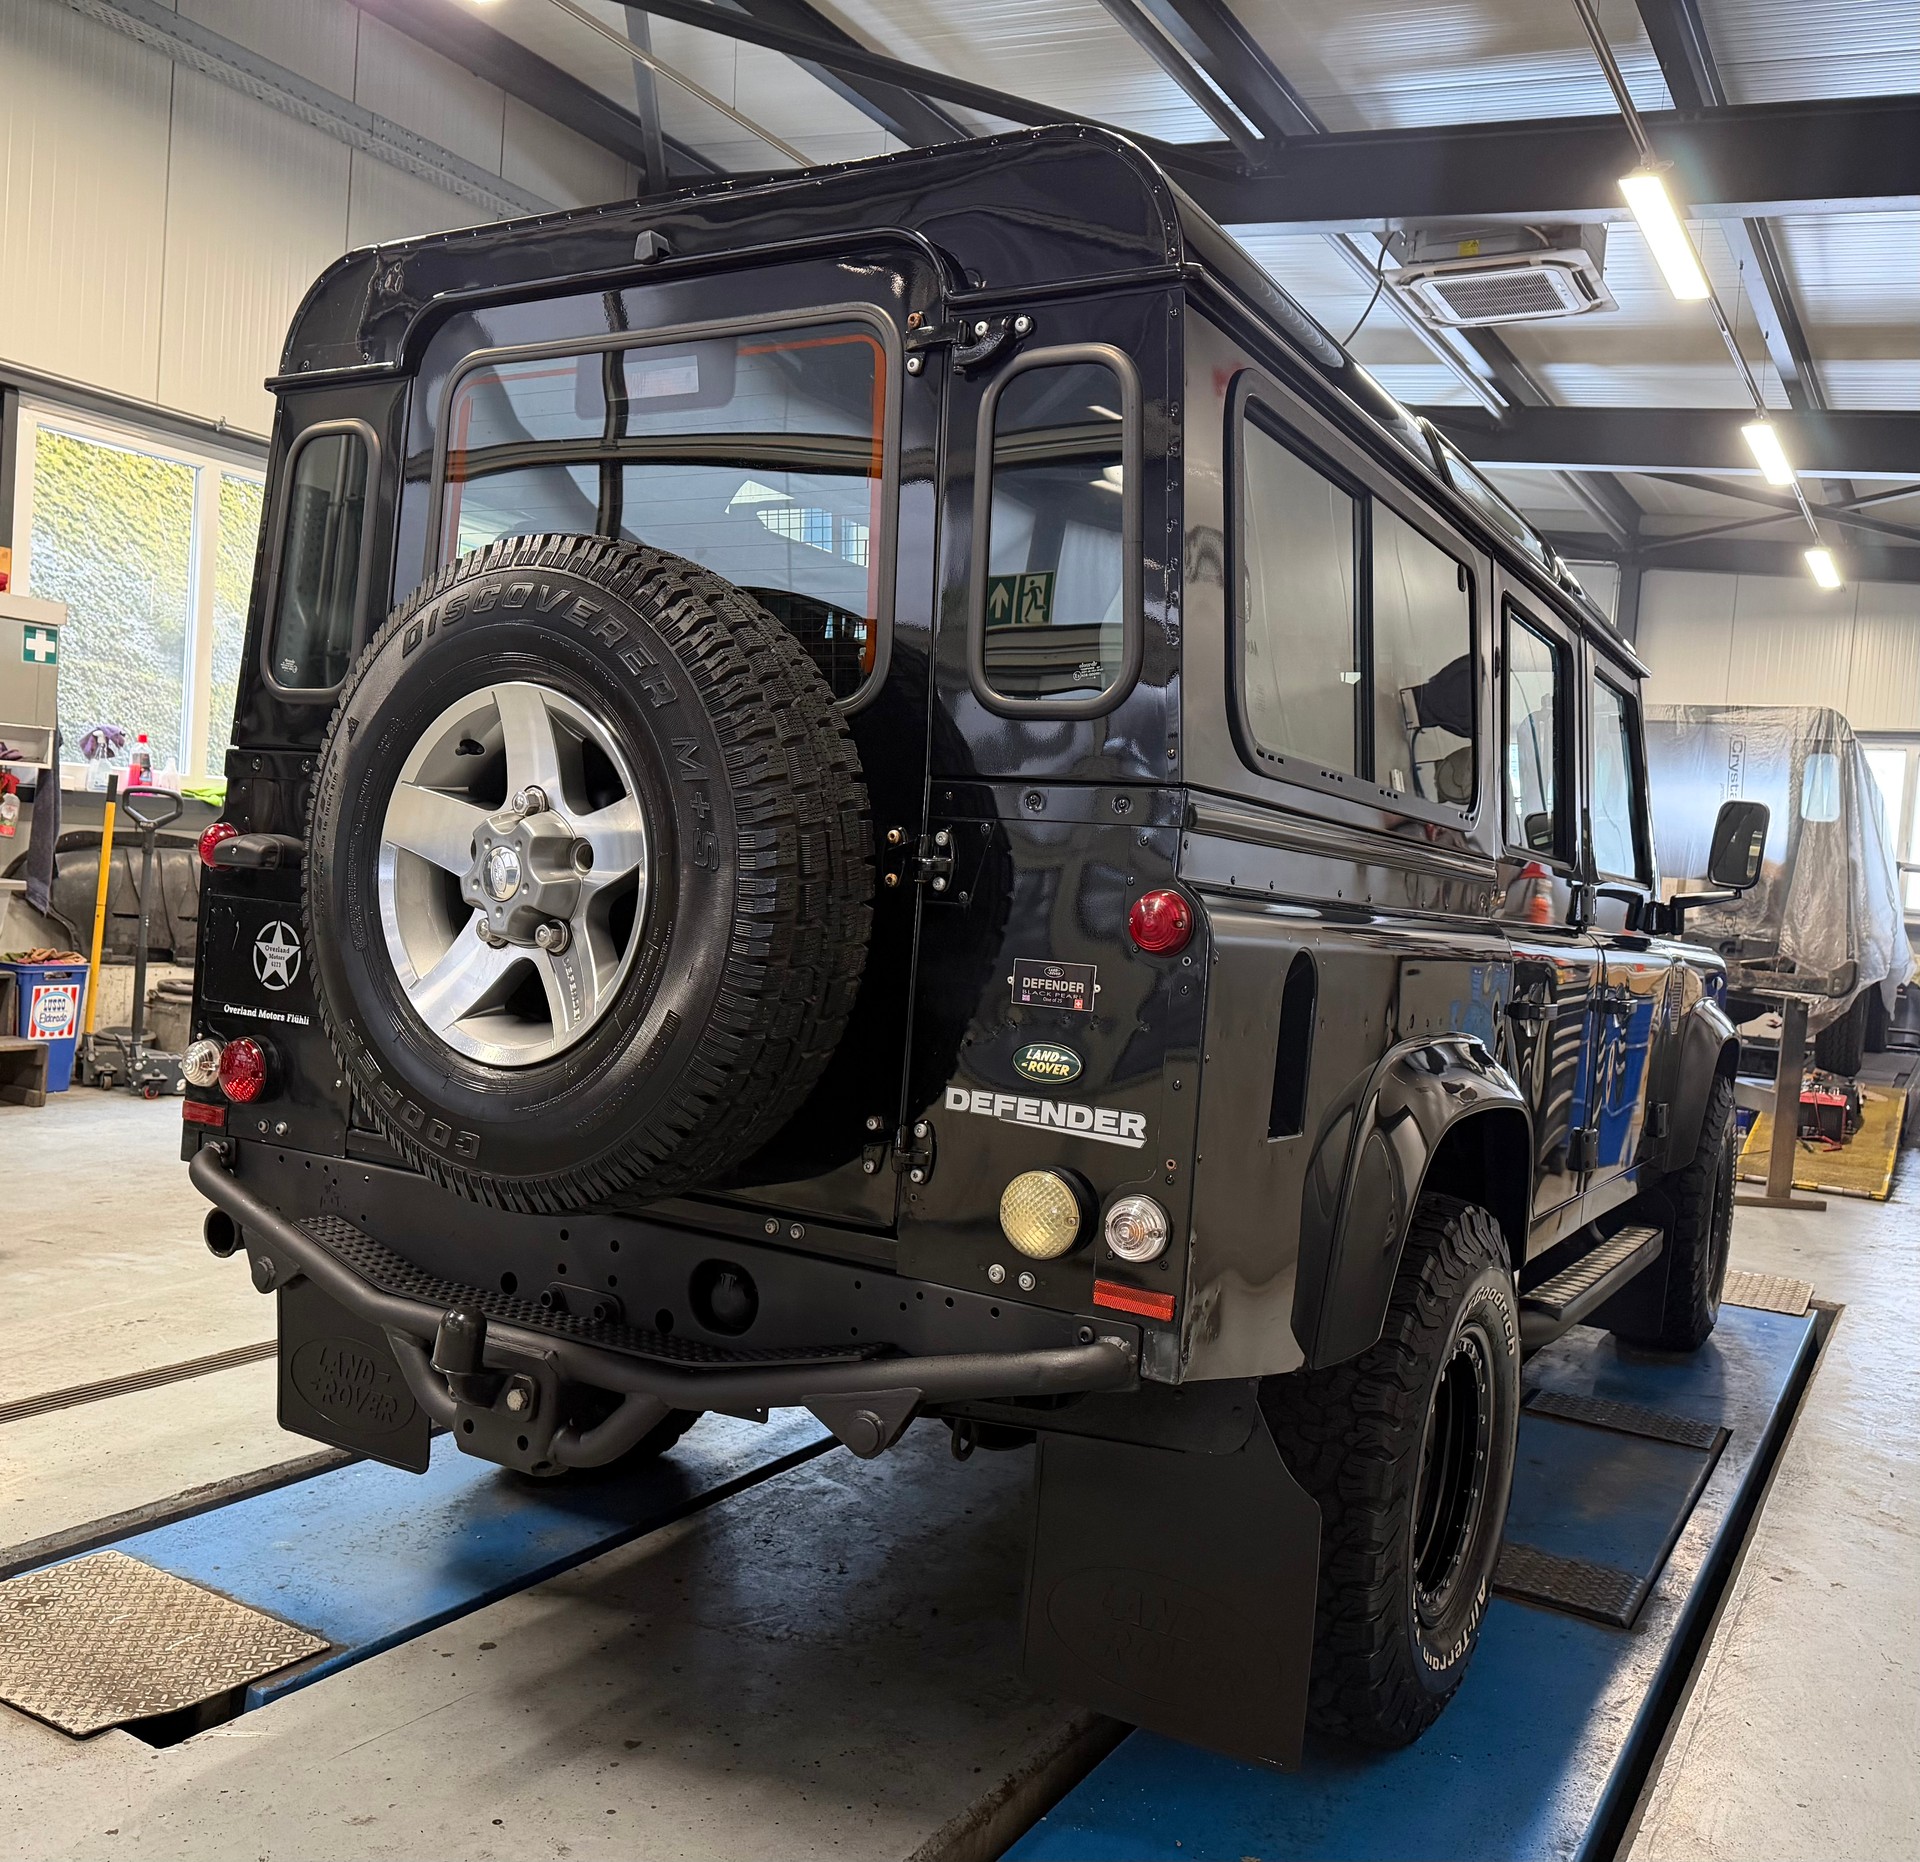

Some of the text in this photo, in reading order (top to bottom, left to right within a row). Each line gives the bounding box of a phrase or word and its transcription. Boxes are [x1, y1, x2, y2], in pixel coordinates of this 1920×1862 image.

[402, 582, 678, 709] DISCOVERER
[1022, 977, 1085, 993] DEFENDER
[1022, 989, 1052, 997] BLACK
[223, 1003, 310, 1026] Overland Motors Flühli
[945, 1086, 1148, 1140] DEFENDER
